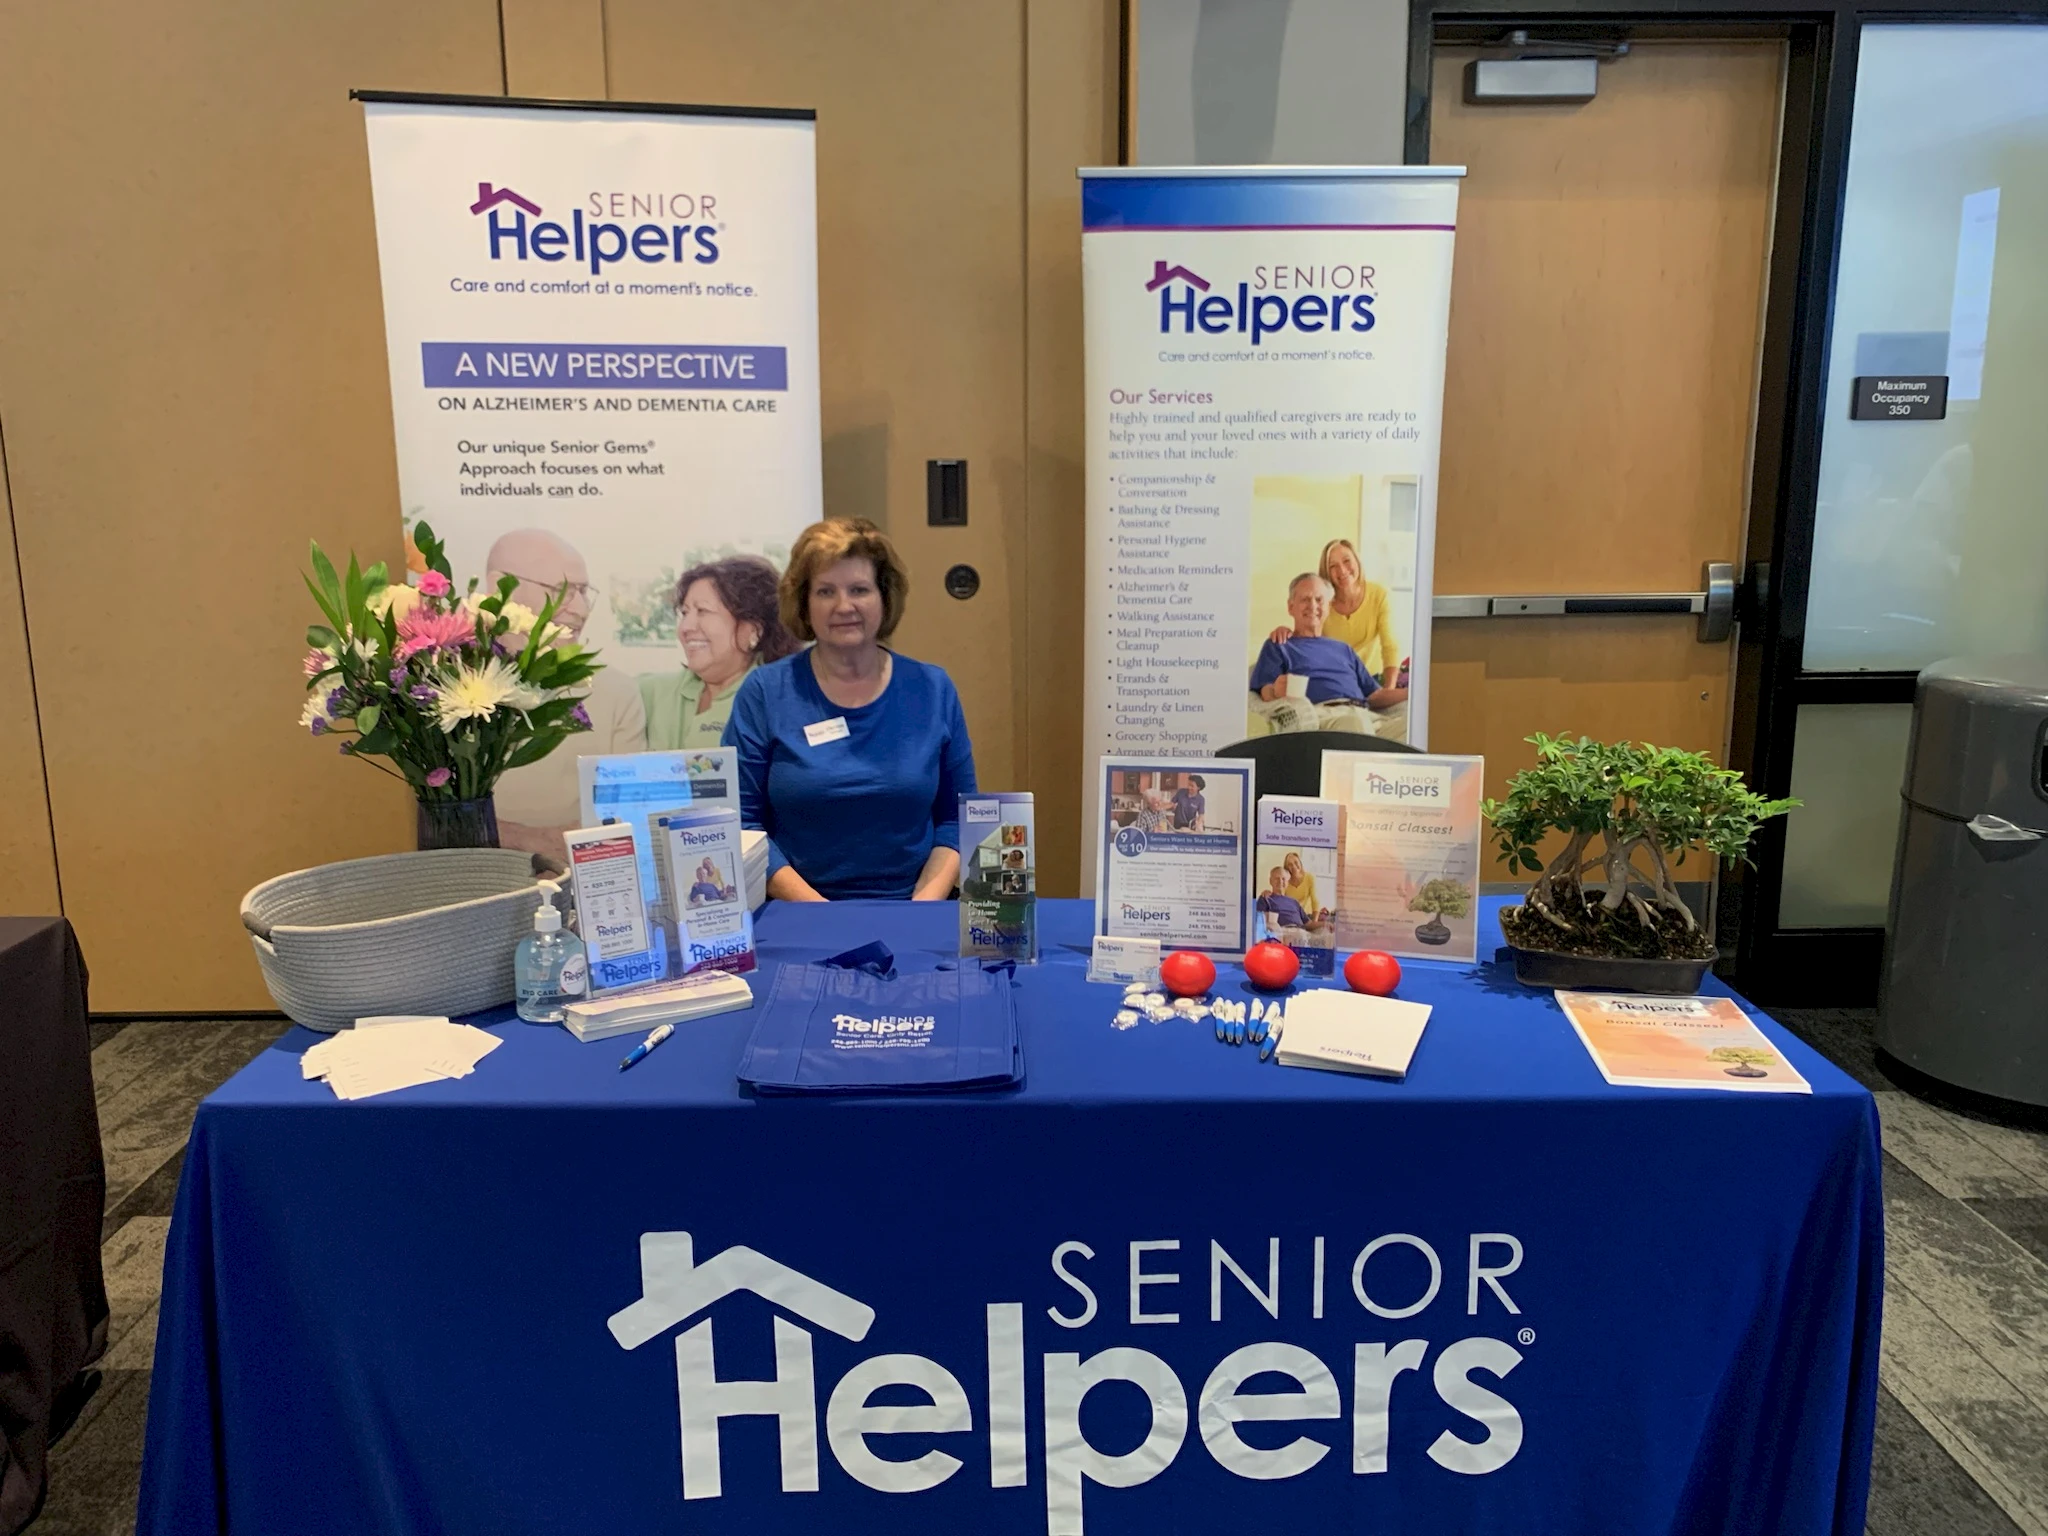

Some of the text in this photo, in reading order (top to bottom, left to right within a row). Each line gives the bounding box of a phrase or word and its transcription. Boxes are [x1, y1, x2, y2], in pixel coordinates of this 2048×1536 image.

[589, 192, 717, 220] SENIOR
[488, 209, 719, 275] Helpers
[1254, 265, 1375, 290] SENIOR
[450, 278, 758, 297] Care and comfort at a moment's notice.
[1160, 282, 1376, 345] Helpers
[1158, 350, 1375, 362] Care and comfort at a moment's notice.
[455, 353, 756, 379] A NEW PERSPECTIVE
[1878, 381, 1926, 390] Maximum
[1109, 388, 1214, 404] Our Services
[1871, 393, 1930, 404] Occupancy
[438, 397, 777, 413] ON ALZHEIMER'S AND DEMENTIA CARE
[1889, 405, 1910, 415] 350
[1109, 409, 1416, 427] Highly trained and qualified caregivers are ready to
[1109, 427, 1420, 444] help you and your loved ones with a variety of daily
[457, 440, 488, 454] Our
[493, 442, 546, 457] unique
[551, 440, 599, 454] Senior
[1109, 447, 1238, 460] activities that include:
[460, 461, 665, 478] Approach focuses on what
[1118, 474, 1216, 486] Companionship &
[460, 483, 603, 498] individuals can do.
[1118, 488, 1187, 498] Conversation
[1118, 504, 1220, 517] Bathing & Dressing
[1118, 518, 1171, 528] Assistance
[1118, 535, 1207, 547] Personal Hygiene
[1118, 548, 1170, 559] Assistance
[1117, 564, 1233, 575] Medication Reminders
[1117, 581, 1189, 592] Alzheimer's &
[1117, 594, 1193, 605] Dementia Care
[1117, 611, 1215, 623] Walking Assistance
[1117, 628, 1217, 640] Meal Preparation &
[1116, 640, 1159, 652] Cleanup
[1116, 657, 1219, 669] Light Housekeeping
[1116, 673, 1169, 683] Errands &
[1116, 686, 1190, 697] Transportation
[1116, 702, 1204, 714] Laundry & Linen
[1115, 715, 1165, 727] Changing
[1115, 731, 1208, 743] Grocery Shopping
[1159, 747, 1169, 757] &
[1172, 747, 1202, 757] Escort
[1400, 776, 1440, 785] SENIOR
[1370, 780, 1439, 799] Helpers
[970, 808, 997, 816] Helpers
[1274, 813, 1323, 827] Helpers
[1398, 822, 1453, 835] Classes!
[684, 832, 726, 845] Helpers
[1120, 832, 1128, 843] 9
[1130, 843, 1143, 853] 10
[968, 900, 1000, 908] Providing
[1123, 909, 1171, 922] Helpers
[598, 924, 632, 936] Helpers
[693, 943, 747, 962] Helpers
[604, 961, 661, 982] Helpers
[1617, 1003, 1694, 1012] Helpers
[880, 1016, 935, 1024] SENIOR
[837, 1019, 935, 1034] Helpers
[1047, 1232, 1524, 1328] SENIOR
